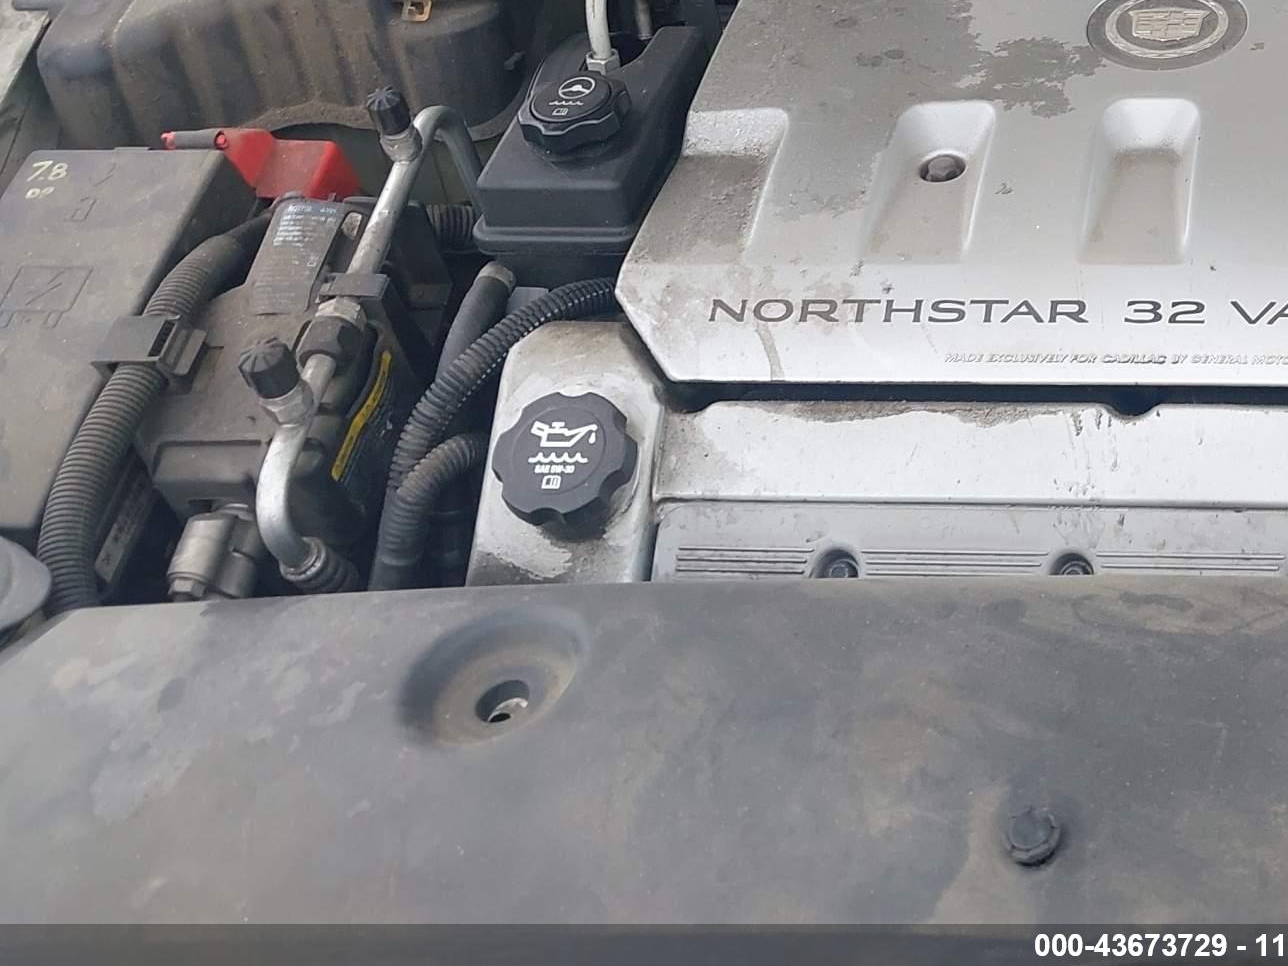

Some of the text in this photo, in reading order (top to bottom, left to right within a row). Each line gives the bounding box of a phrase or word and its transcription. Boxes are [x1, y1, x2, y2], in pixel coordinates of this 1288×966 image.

[708, 298, 1089, 323] NORTHSTAR
[1123, 299, 1206, 324] 32
[944, 353, 985, 363] MADE
[986, 353, 1069, 364] EXCLUSIVELY
[1069, 353, 1098, 364] FOR
[1101, 353, 1168, 365] CADILLAC
[1171, 354, 1189, 365] BY
[1191, 354, 1248, 365] GENERAL
